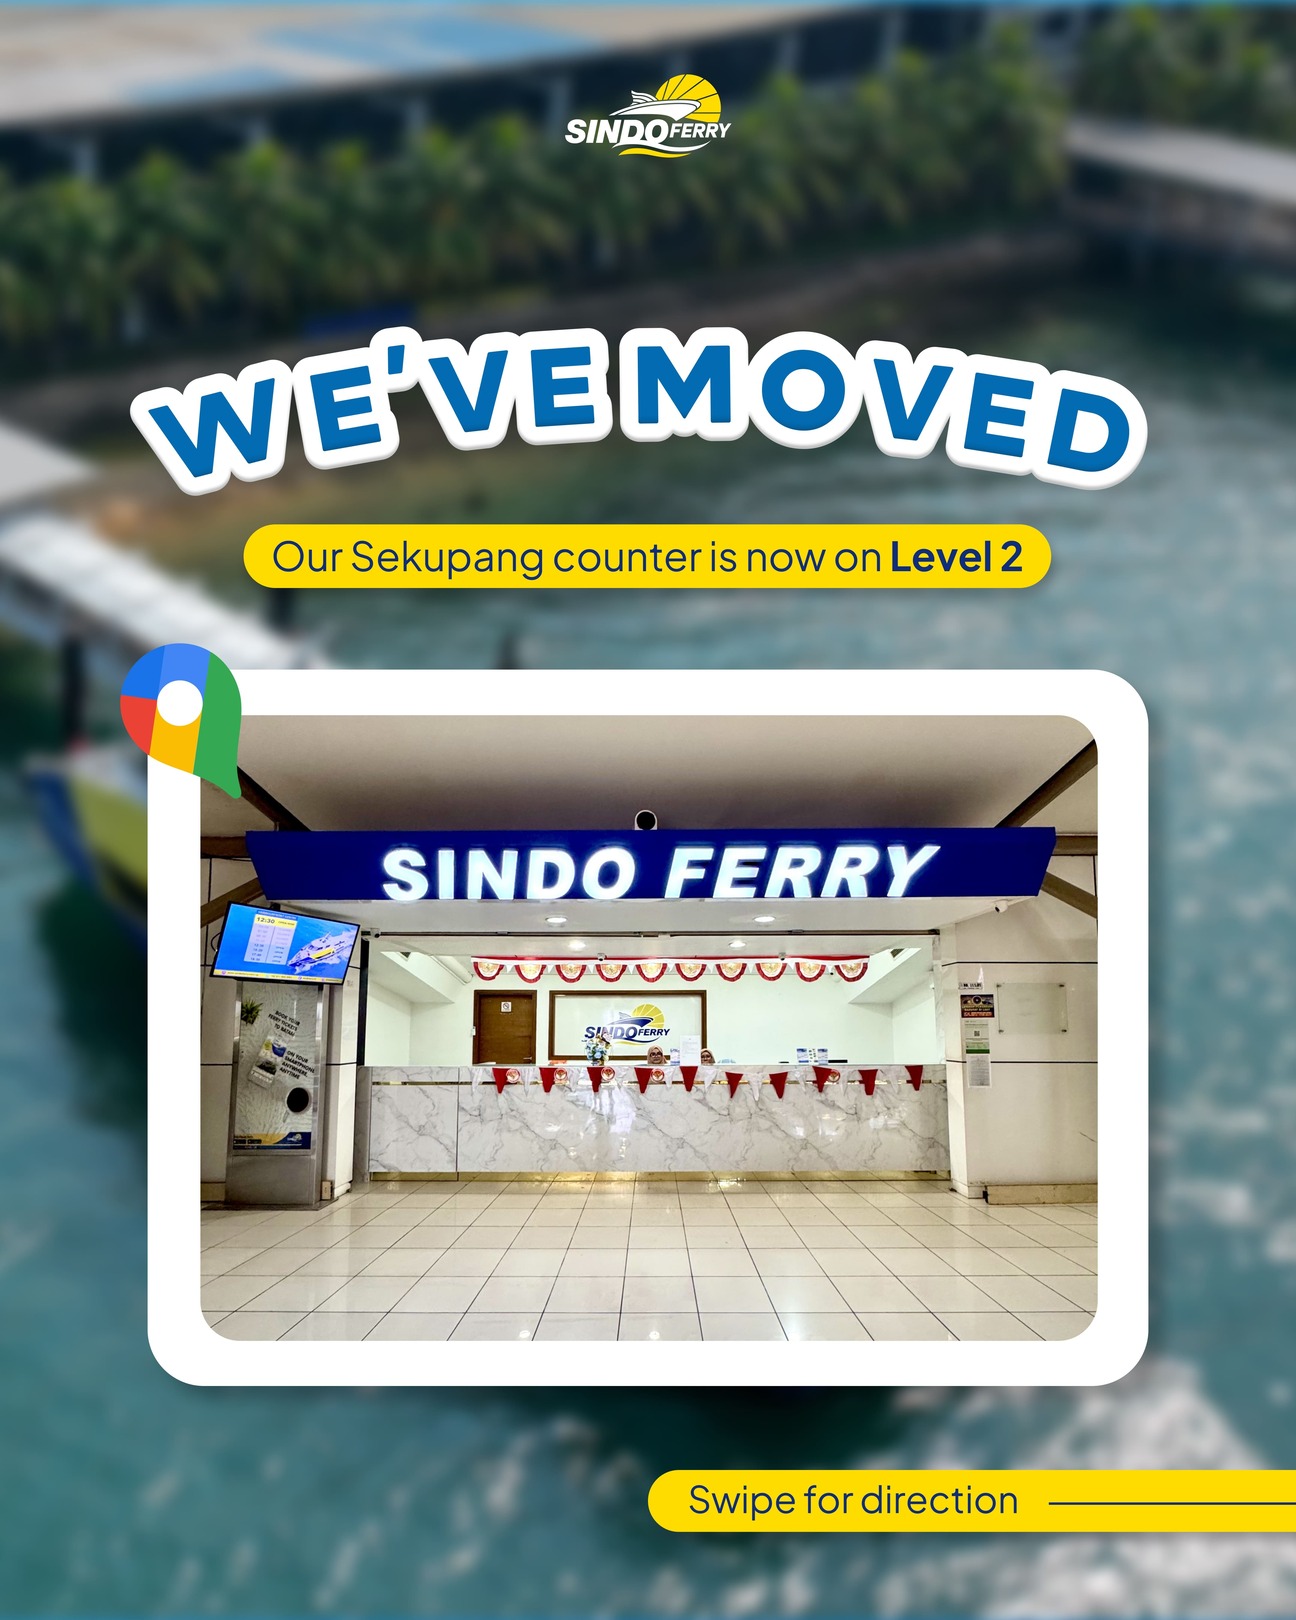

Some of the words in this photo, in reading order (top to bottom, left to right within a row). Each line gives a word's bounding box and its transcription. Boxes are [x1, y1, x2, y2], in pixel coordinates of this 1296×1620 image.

[382, 846, 636, 901] SINDO
[664, 844, 941, 899] FERRY
[257, 916, 276, 924] 12:30
[274, 1010, 289, 1020] BOOK
[268, 1013, 281, 1023] FERRY
[281, 1020, 298, 1032] TICKETS
[280, 1026, 296, 1037] BATAM
[584, 1026, 638, 1039] SINDO
[637, 1028, 671, 1036] FERRY
[295, 1053, 309, 1063] YOUR
[279, 1066, 300, 1080] ANYTIME
